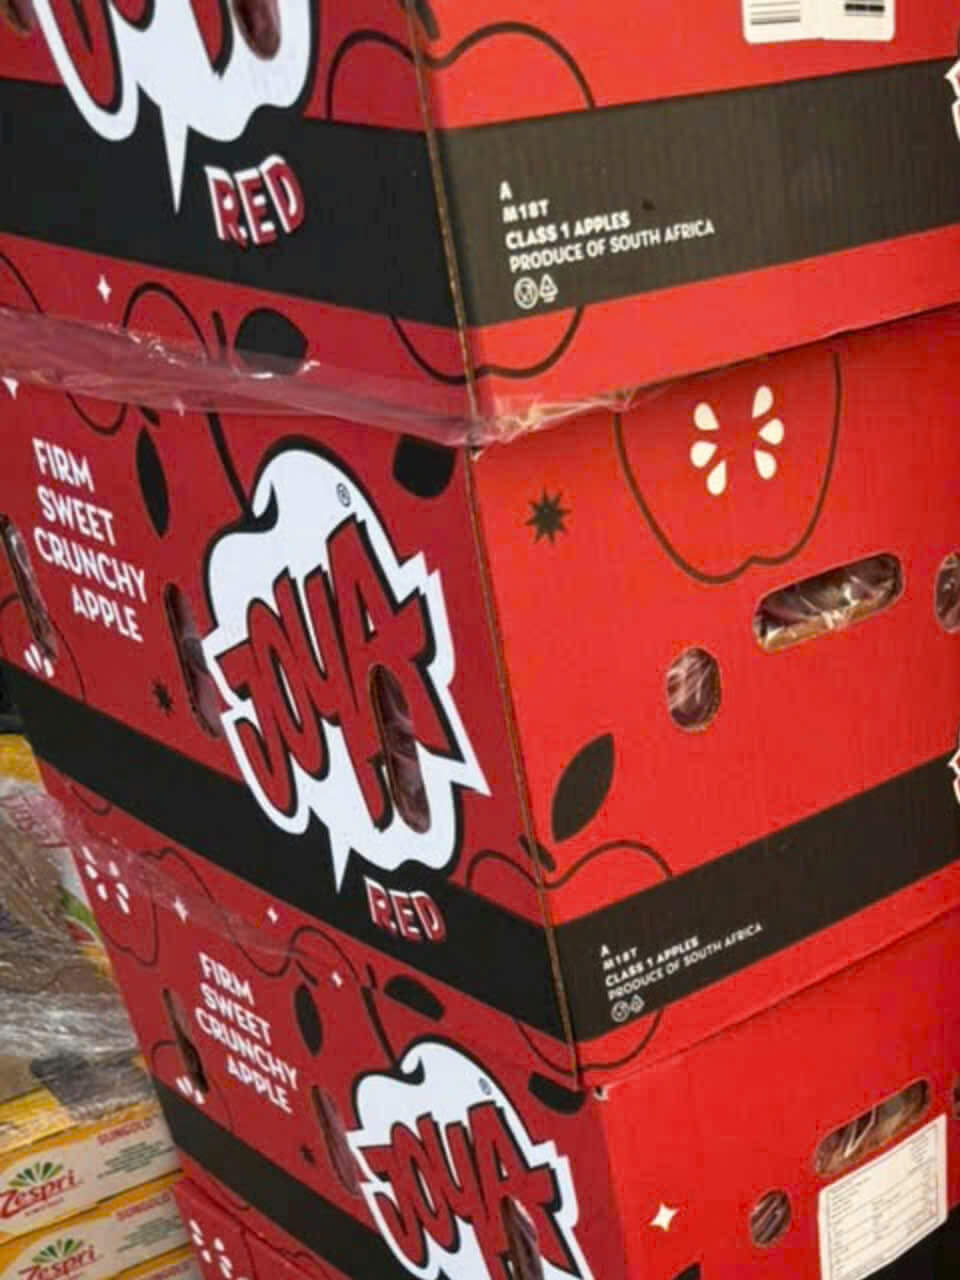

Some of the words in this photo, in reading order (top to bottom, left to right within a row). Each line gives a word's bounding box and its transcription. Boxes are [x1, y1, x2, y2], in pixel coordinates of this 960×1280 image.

[203, 154, 305, 249] RED
[500, 180, 513, 200] A
[505, 224, 559, 251] CLASS
[560, 221, 571, 239] 1
[574, 210, 631, 237] APPLES
[509, 242, 584, 273] PRODUCE
[586, 238, 605, 258] OF
[609, 228, 661, 253] SOUTH
[664, 218, 715, 243] AFRICA
[32, 437, 95, 493] FIRM
[37, 484, 117, 547] SWEET
[33, 526, 147, 604] CRUNCHY
[72, 584, 144, 643] APPLE
[215, 511, 467, 832] JOYA
[364, 874, 446, 944] RED
[198, 952, 255, 1007] FIRM
[605, 961, 644, 987] CLASS
[646, 956, 654, 968] 1
[656, 935, 700, 964] APPLES
[608, 966, 664, 1000] PRODUCE
[666, 959, 681, 976] OF
[683, 940, 723, 968] SOUTH
[724, 921, 763, 948] AFRICA
[200, 981, 271, 1046] SWEET
[195, 1006, 298, 1091] CRUNCHY
[226, 1055, 293, 1114] APPLE
[0, 1170, 76, 1219] Zespri
